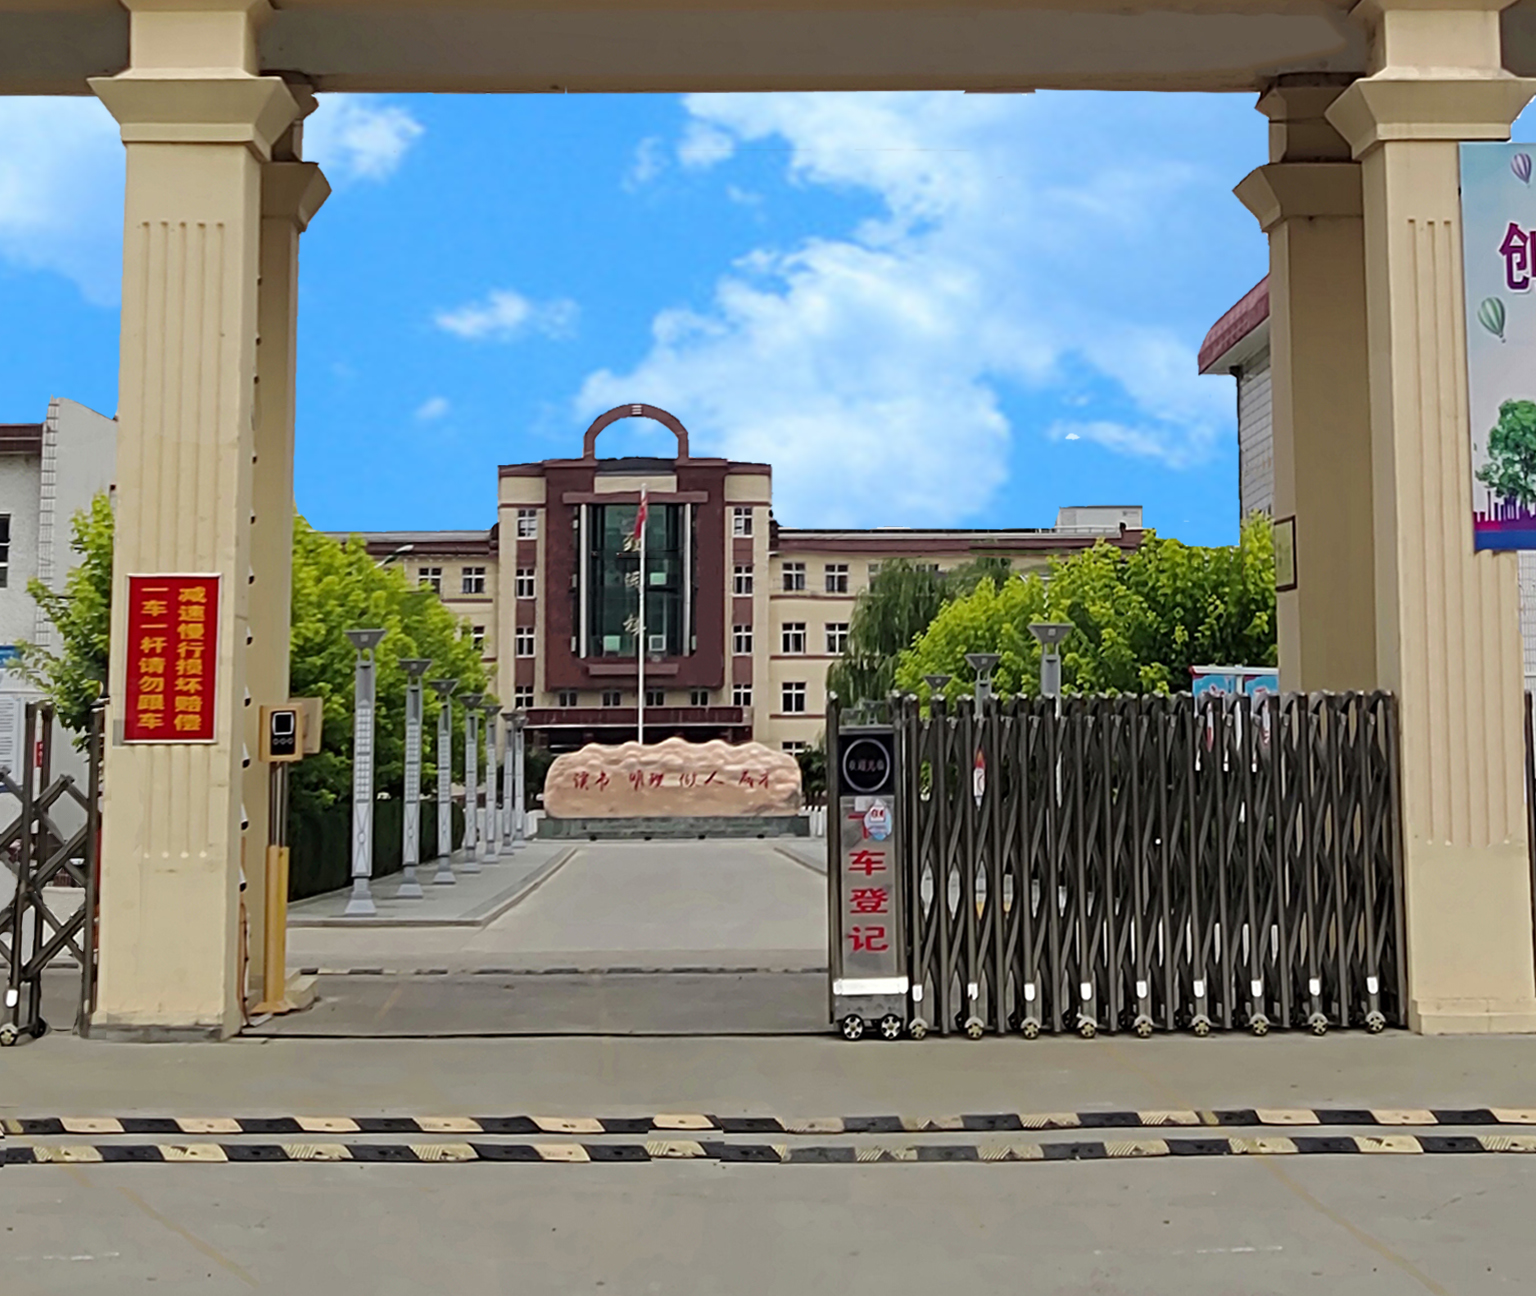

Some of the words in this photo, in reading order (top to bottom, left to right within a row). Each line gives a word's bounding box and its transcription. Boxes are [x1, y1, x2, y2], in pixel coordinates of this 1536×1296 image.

[136, 586, 169, 730] 一车一杆请勿跟车
[174, 586, 207, 731] 减速慢行损坏赔偿
